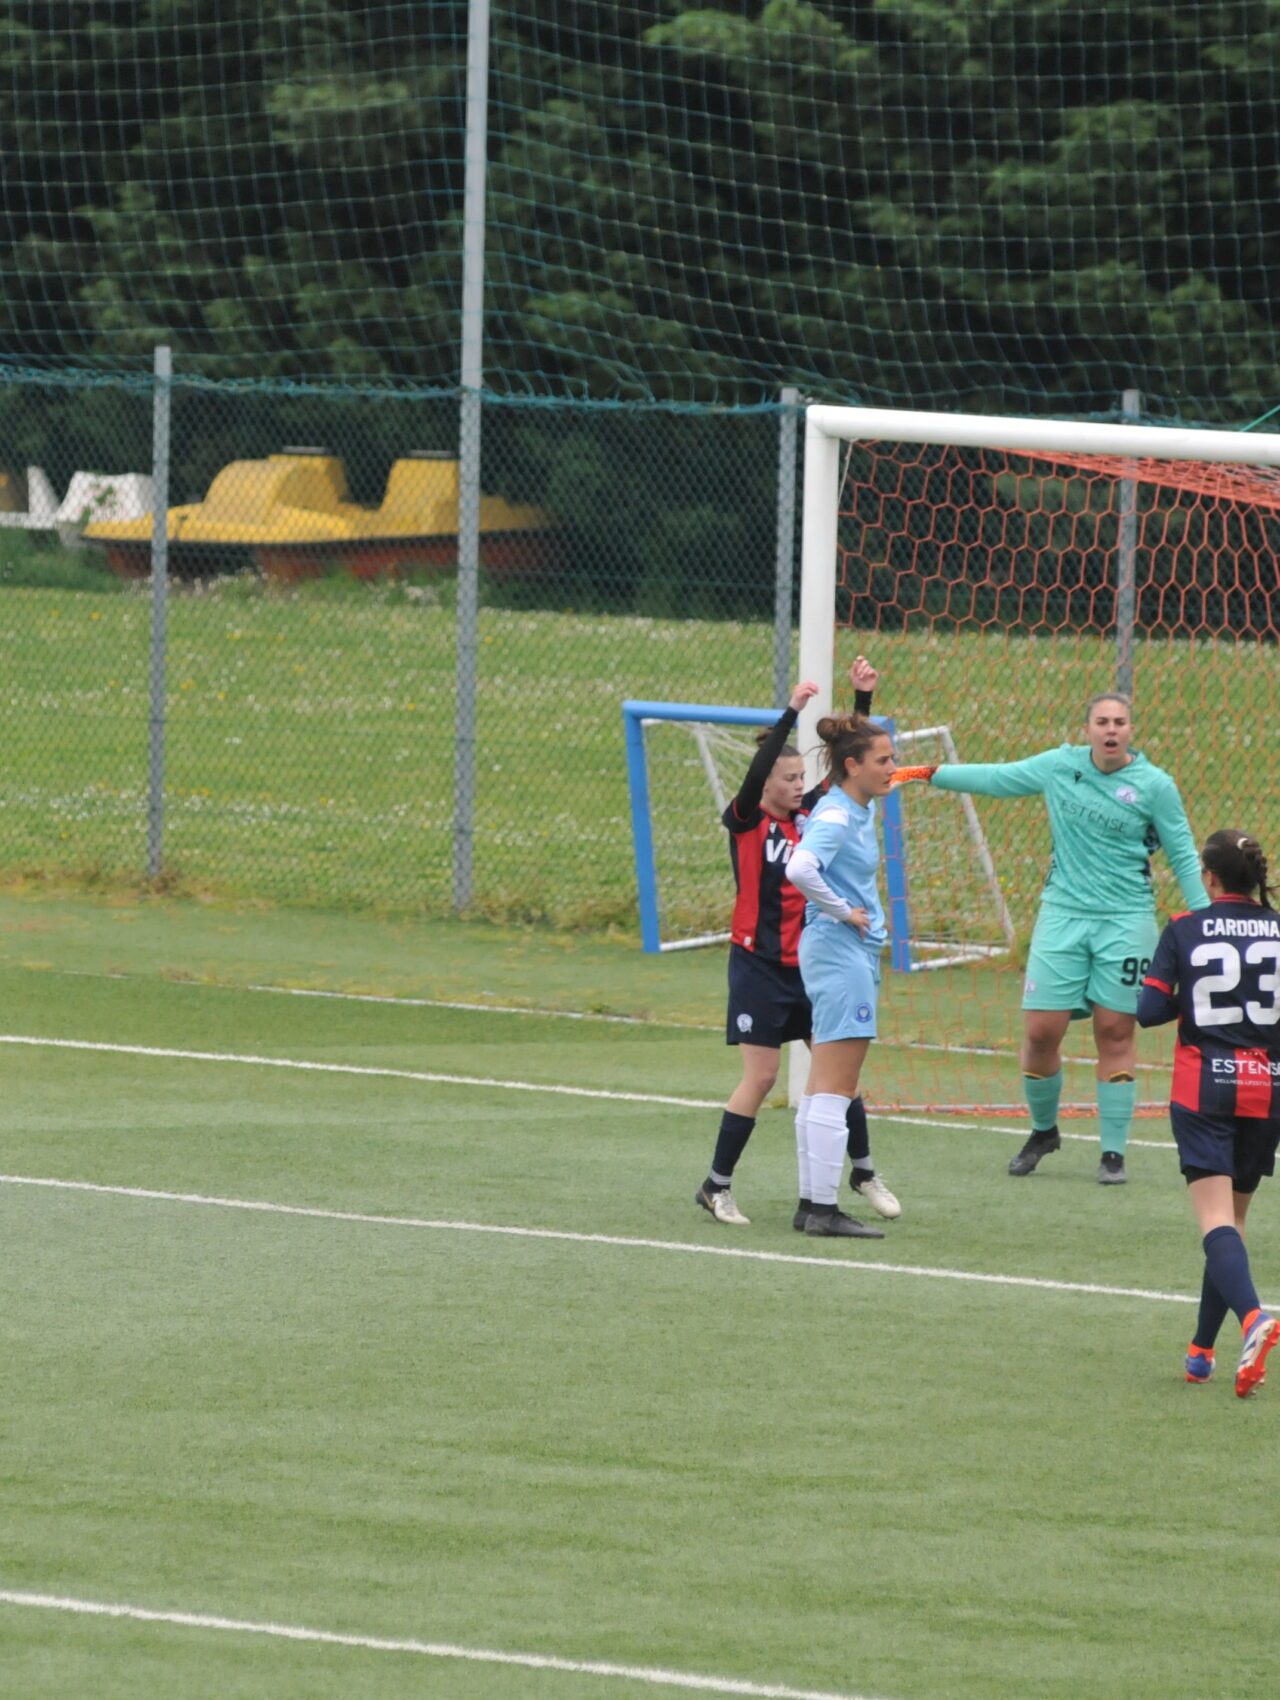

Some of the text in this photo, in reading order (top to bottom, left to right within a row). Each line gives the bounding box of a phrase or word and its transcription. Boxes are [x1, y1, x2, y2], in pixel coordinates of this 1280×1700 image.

[1061, 800, 1129, 833] ESTENSE
[1202, 918, 1280, 937] CARDONA
[1190, 941, 1280, 1027] 23
[1212, 1059, 1280, 1076] ESTENS
